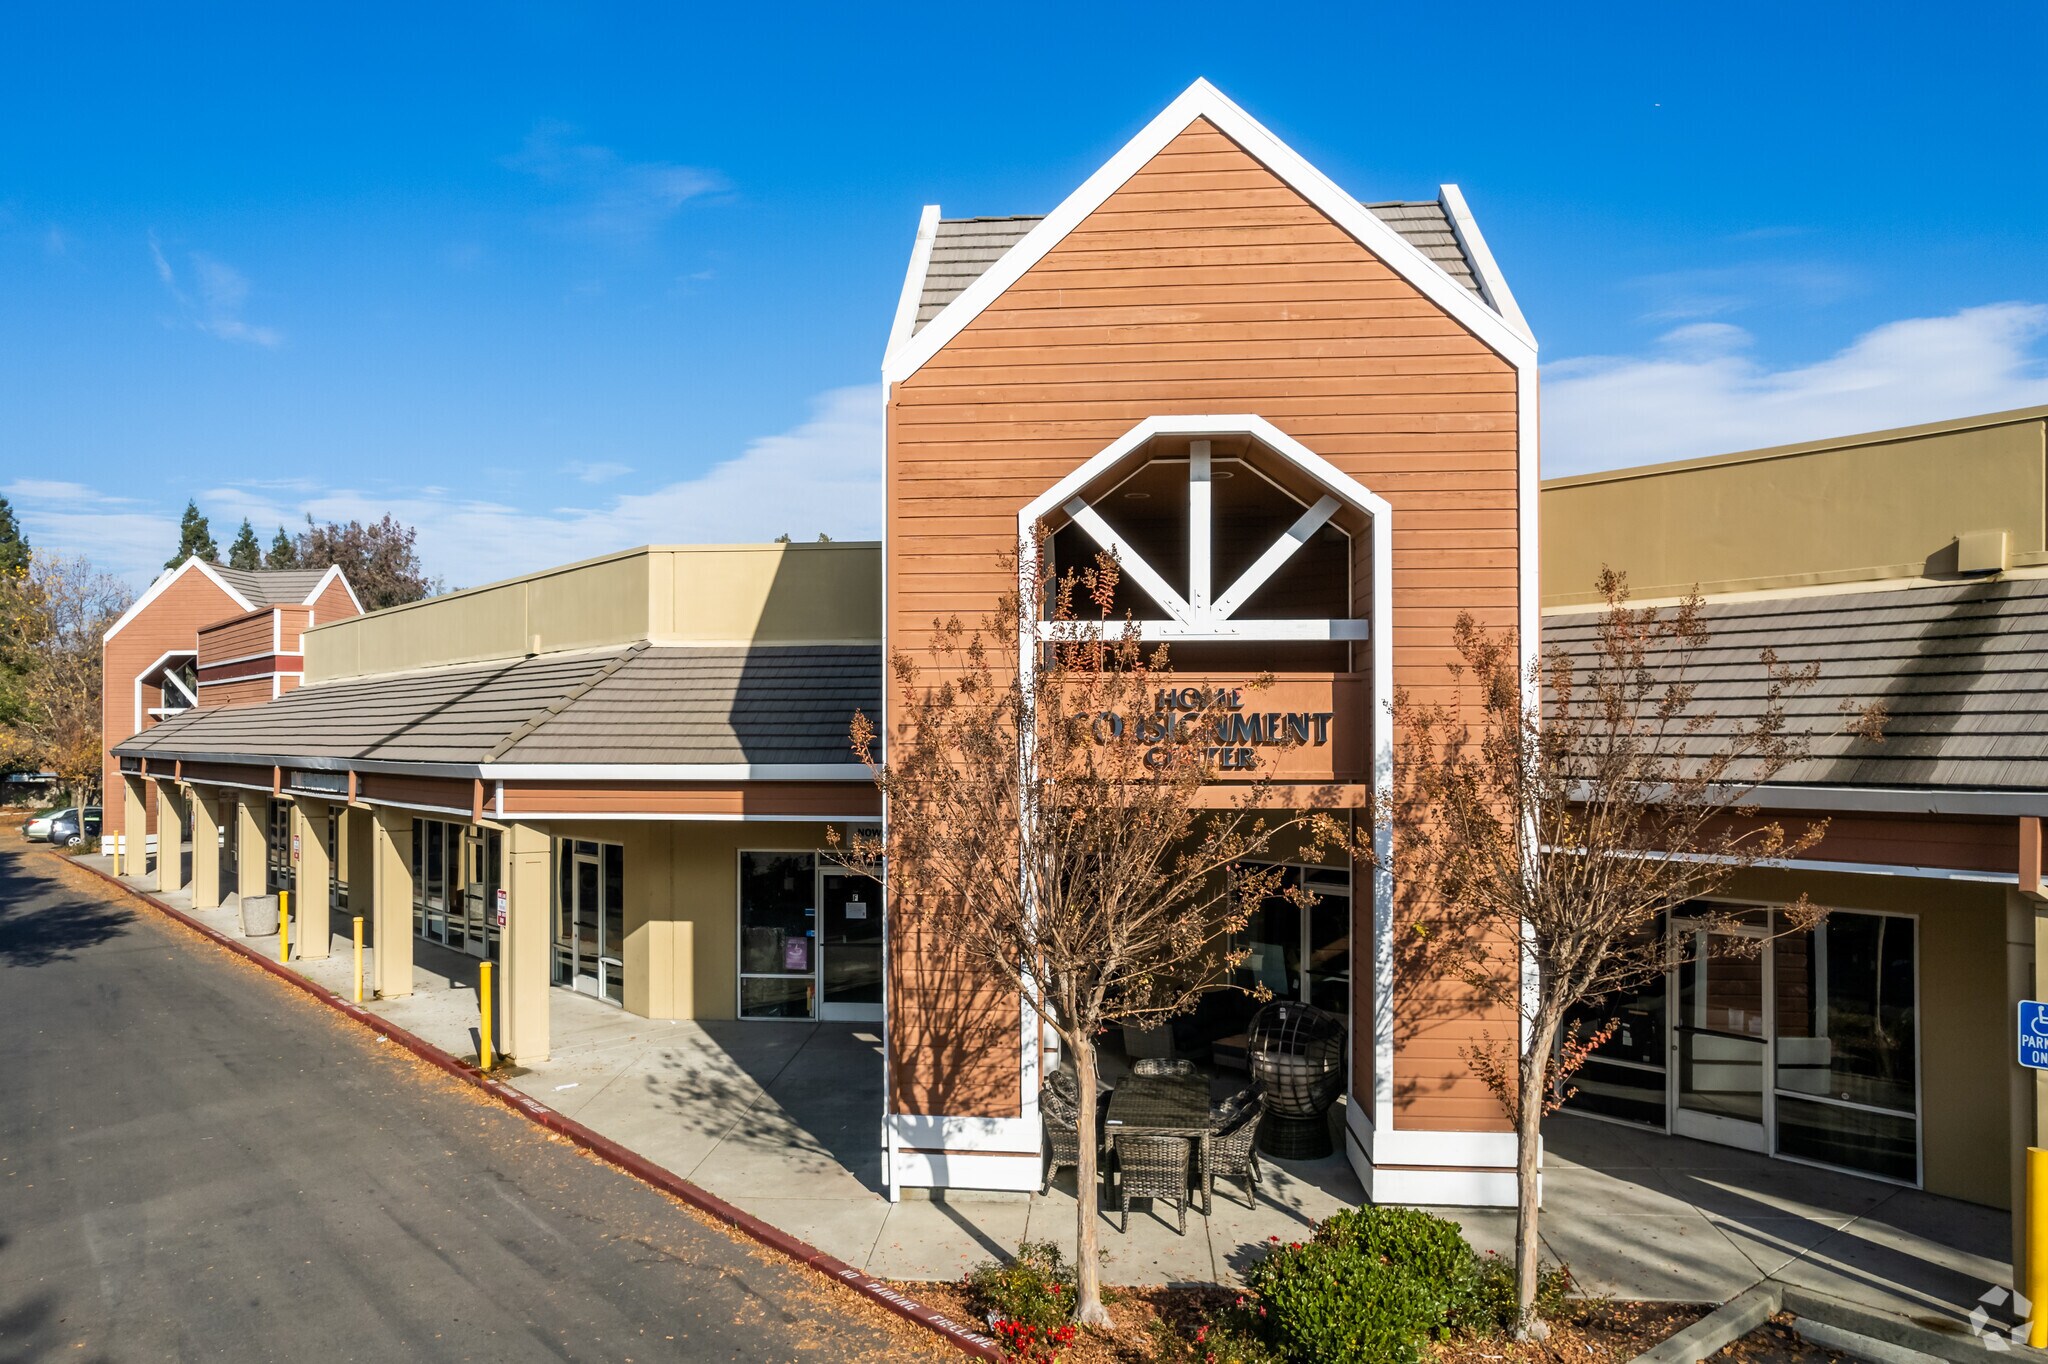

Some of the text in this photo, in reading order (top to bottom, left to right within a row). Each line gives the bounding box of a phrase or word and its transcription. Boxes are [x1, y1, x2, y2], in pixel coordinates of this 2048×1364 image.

[857, 828, 882, 837] NOW
[838, 1269, 860, 1279] NO
[866, 1283, 920, 1311] PARKING
